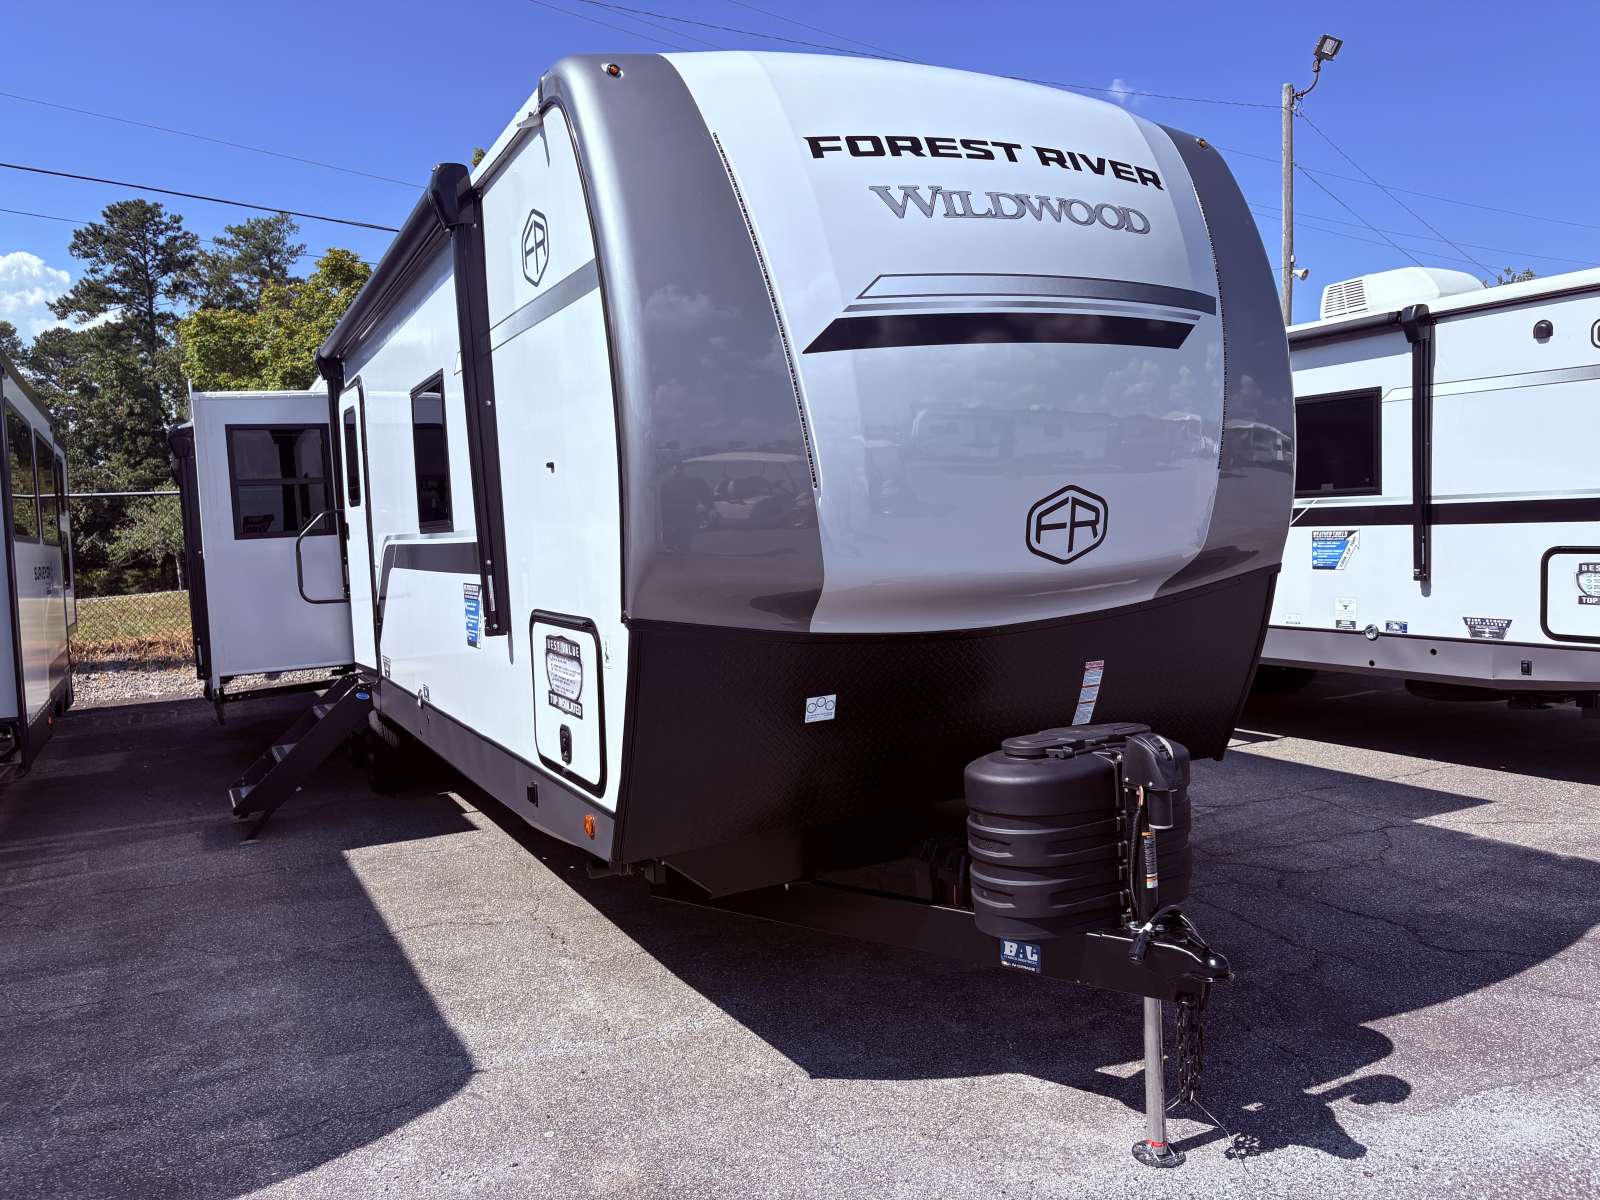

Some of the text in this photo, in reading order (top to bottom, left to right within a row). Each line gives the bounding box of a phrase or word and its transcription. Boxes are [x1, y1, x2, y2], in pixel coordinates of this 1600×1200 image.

[803, 135, 1165, 191] FOREST RIVER
[868, 185, 1151, 234] WILDWOOD
[1034, 494, 1101, 555] FR
